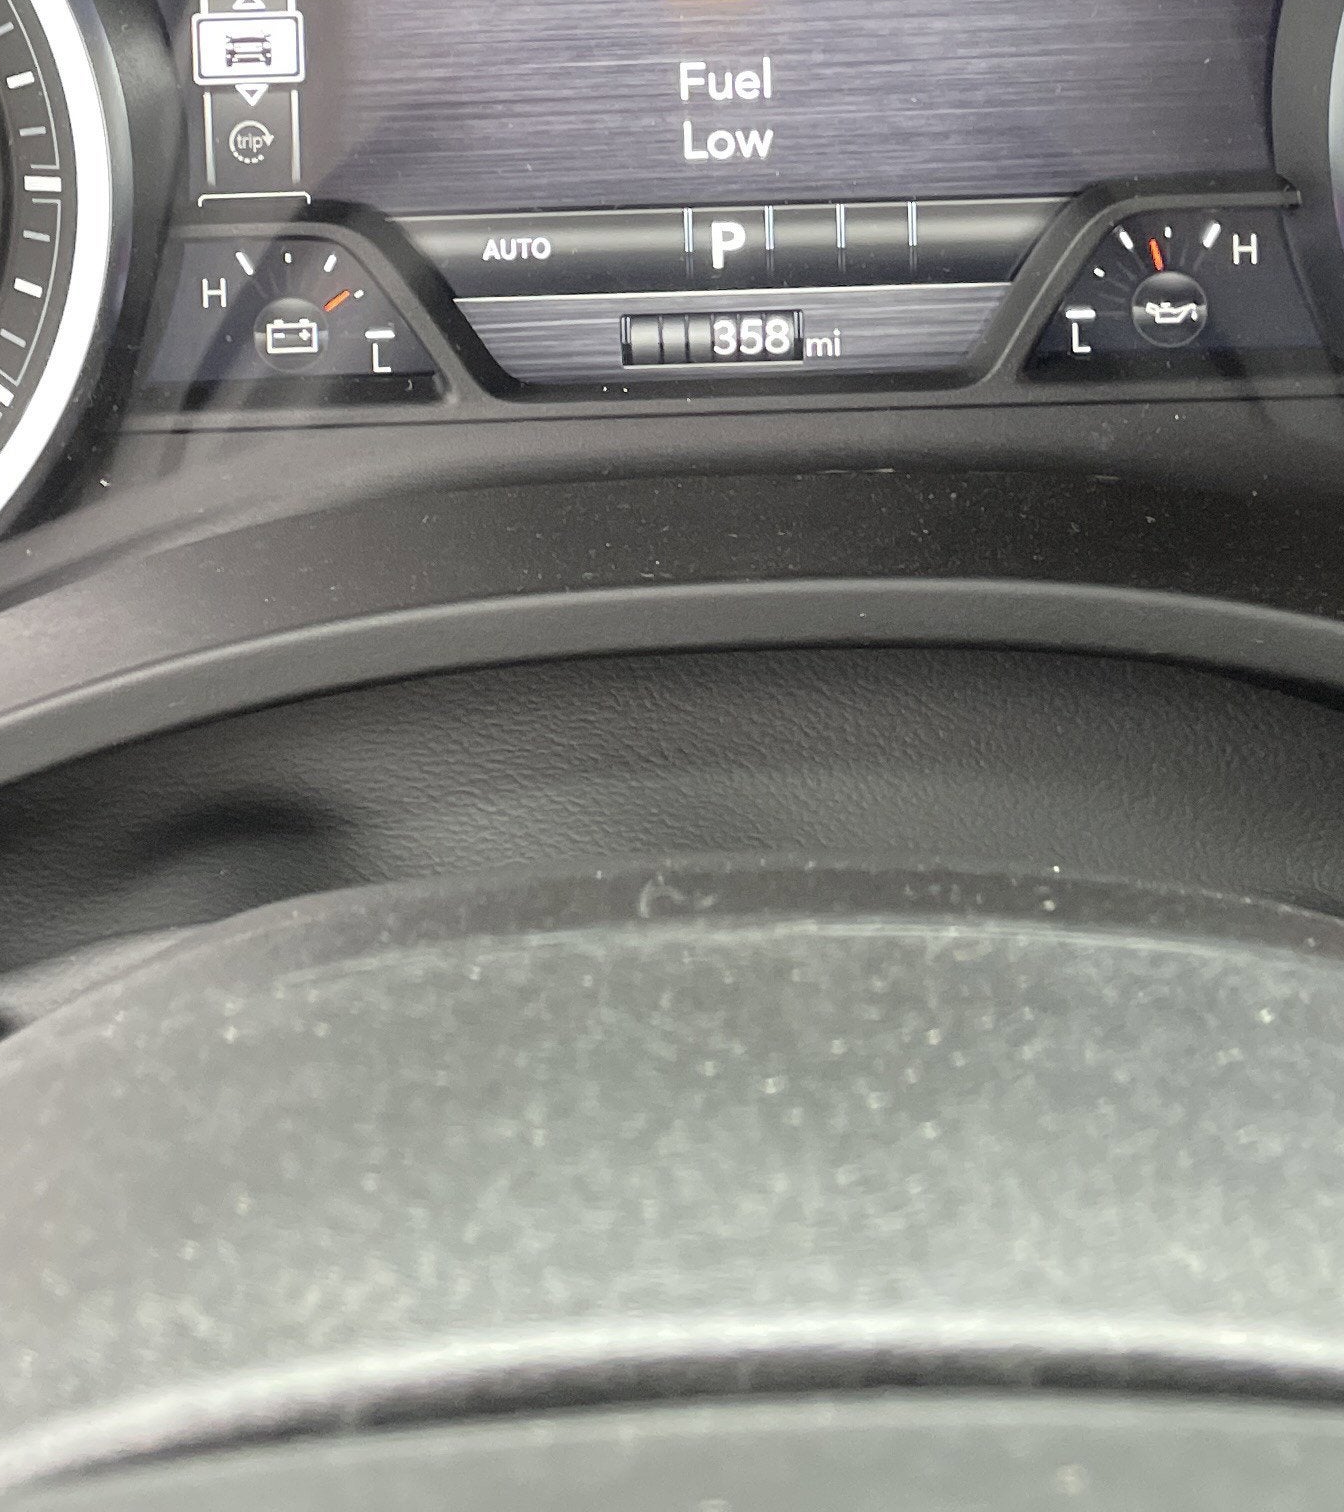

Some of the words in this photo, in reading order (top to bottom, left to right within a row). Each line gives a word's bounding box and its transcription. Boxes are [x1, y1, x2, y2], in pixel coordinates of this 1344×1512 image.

[679, 56, 772, 101] Fuel
[682, 120, 774, 160] Low
[482, 236, 552, 261] AUTO
[711, 221, 746, 270] P
[1232, 233, 1258, 265] H
[201, 278, 227, 308] H
[713, 319, 791, 356] 358
[806, 328, 841, 357] mi
[1072, 322, 1091, 354] L
[372, 343, 392, 373] L
